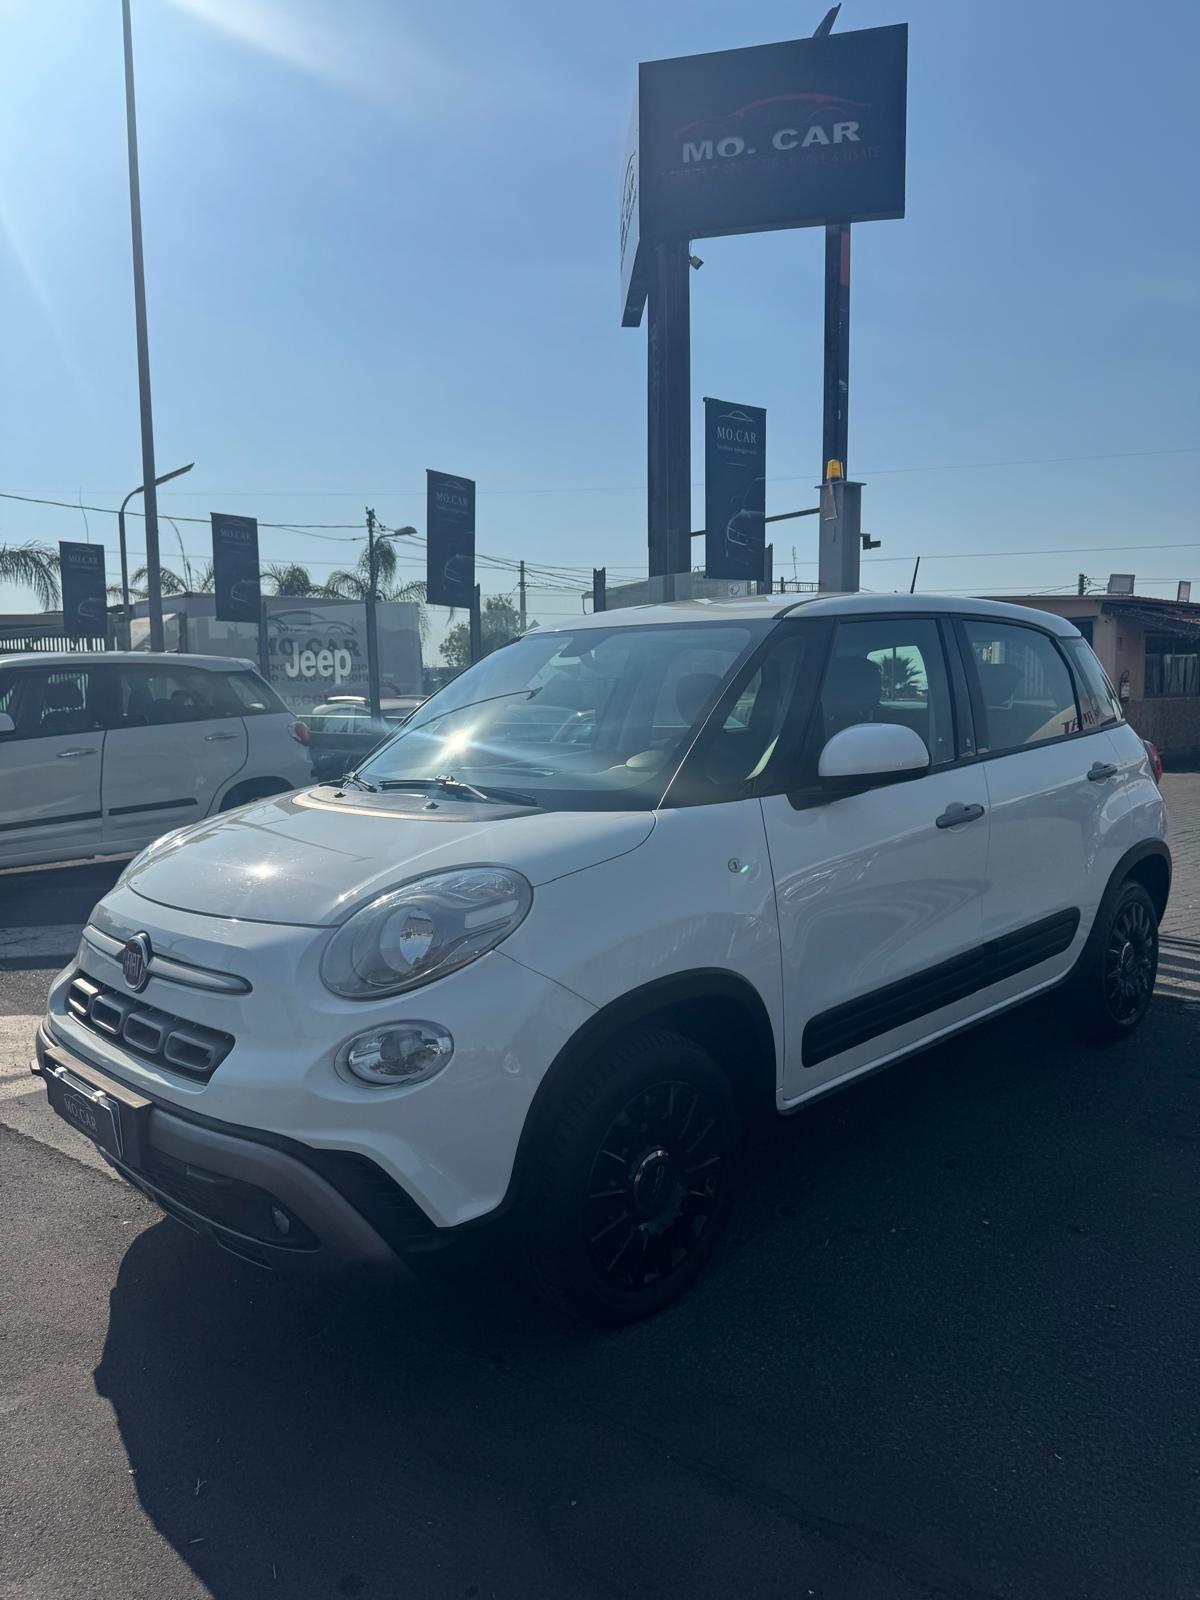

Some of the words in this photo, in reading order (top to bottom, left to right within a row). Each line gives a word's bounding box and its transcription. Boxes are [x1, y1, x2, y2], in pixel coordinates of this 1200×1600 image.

[682, 136, 756, 164] MO.
[771, 120, 861, 151] CAR
[717, 426, 757, 444] MO.CAR
[285, 641, 351, 684] Jeep
